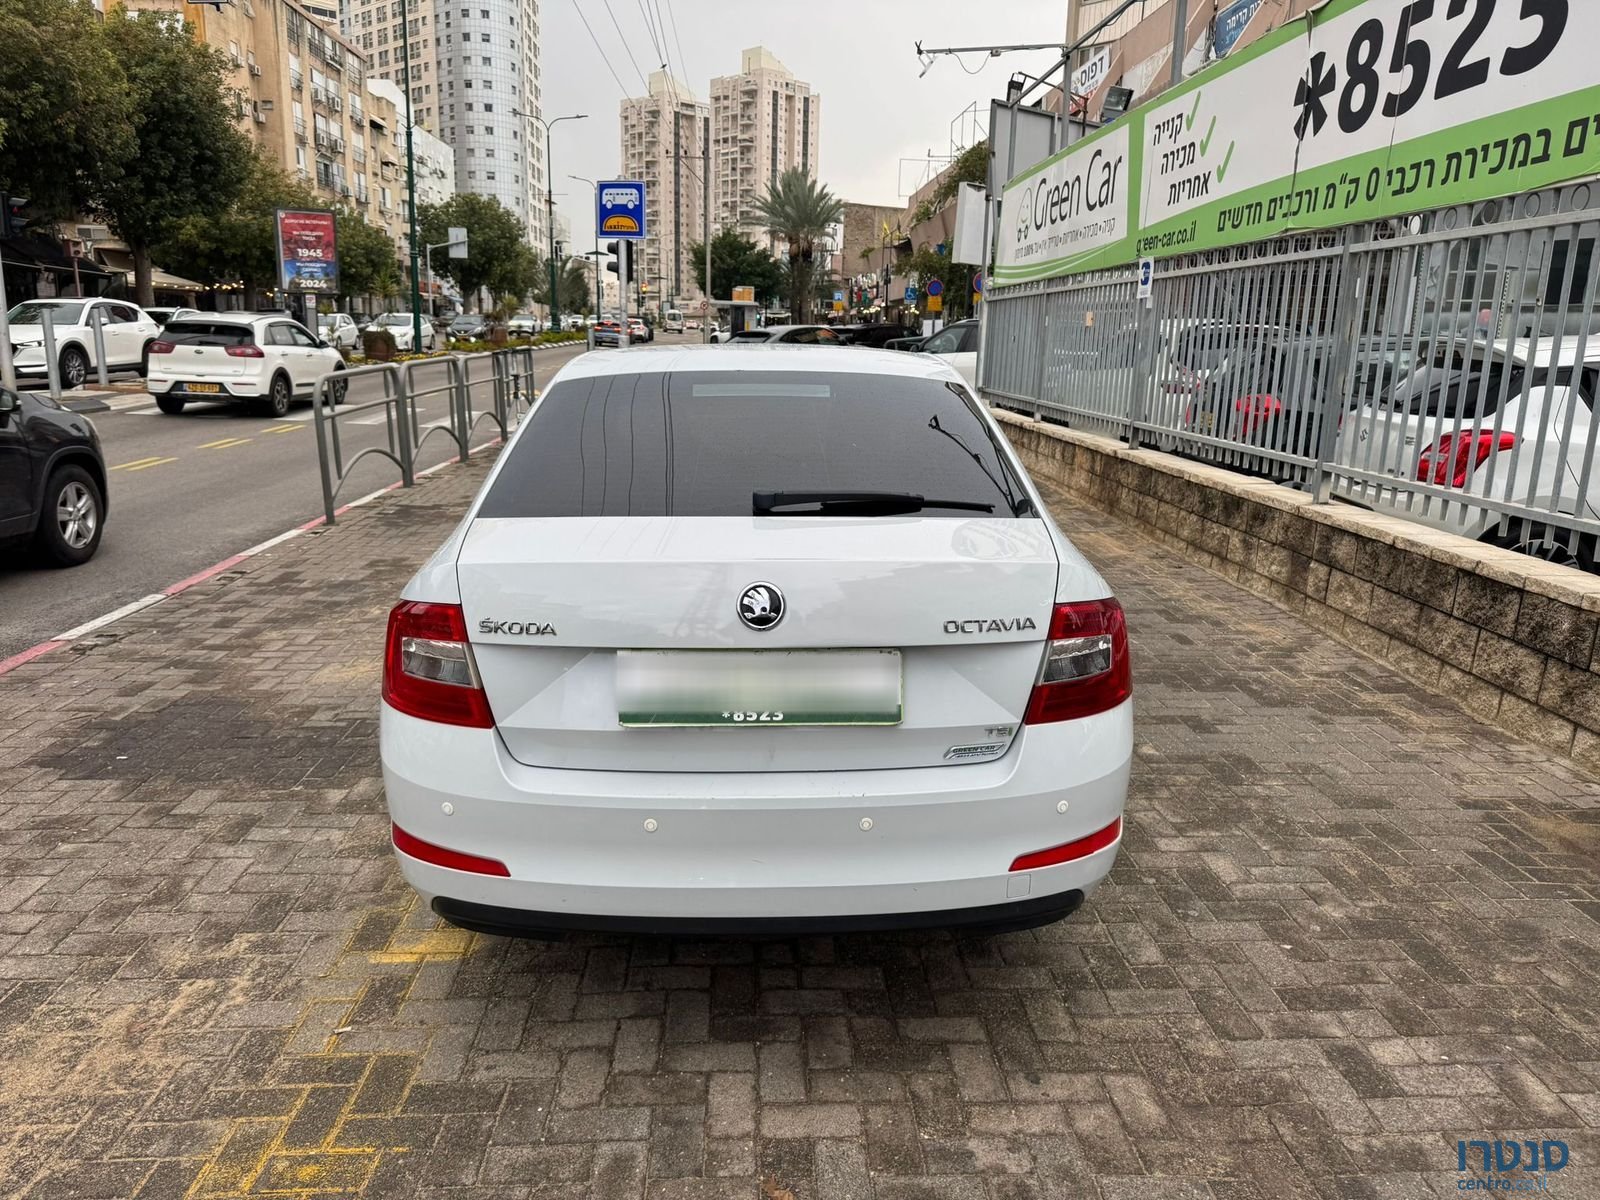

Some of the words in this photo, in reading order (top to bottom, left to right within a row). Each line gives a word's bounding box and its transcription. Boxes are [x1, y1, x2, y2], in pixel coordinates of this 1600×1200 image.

[1081, 55, 1105, 87] דפוס
[1153, 113, 1183, 146] קנייה
[1161, 141, 1196, 175] מכירה
[1441, 128, 1551, 186] במכירת
[1034, 177, 1081, 231] Green
[1086, 149, 1122, 211] Car
[1167, 171, 1211, 206] אחריות
[1366, 167, 1380, 201] 0
[1387, 158, 1435, 197] רכבי
[1217, 202, 1262, 232] חדשים
[1266, 187, 1319, 222] ורכבים
[296, 248, 323, 257] 1945
[300, 279, 328, 288] 2024
[943, 617, 1036, 634] OCTAVIA
[984, 727, 1013, 738] TSI
